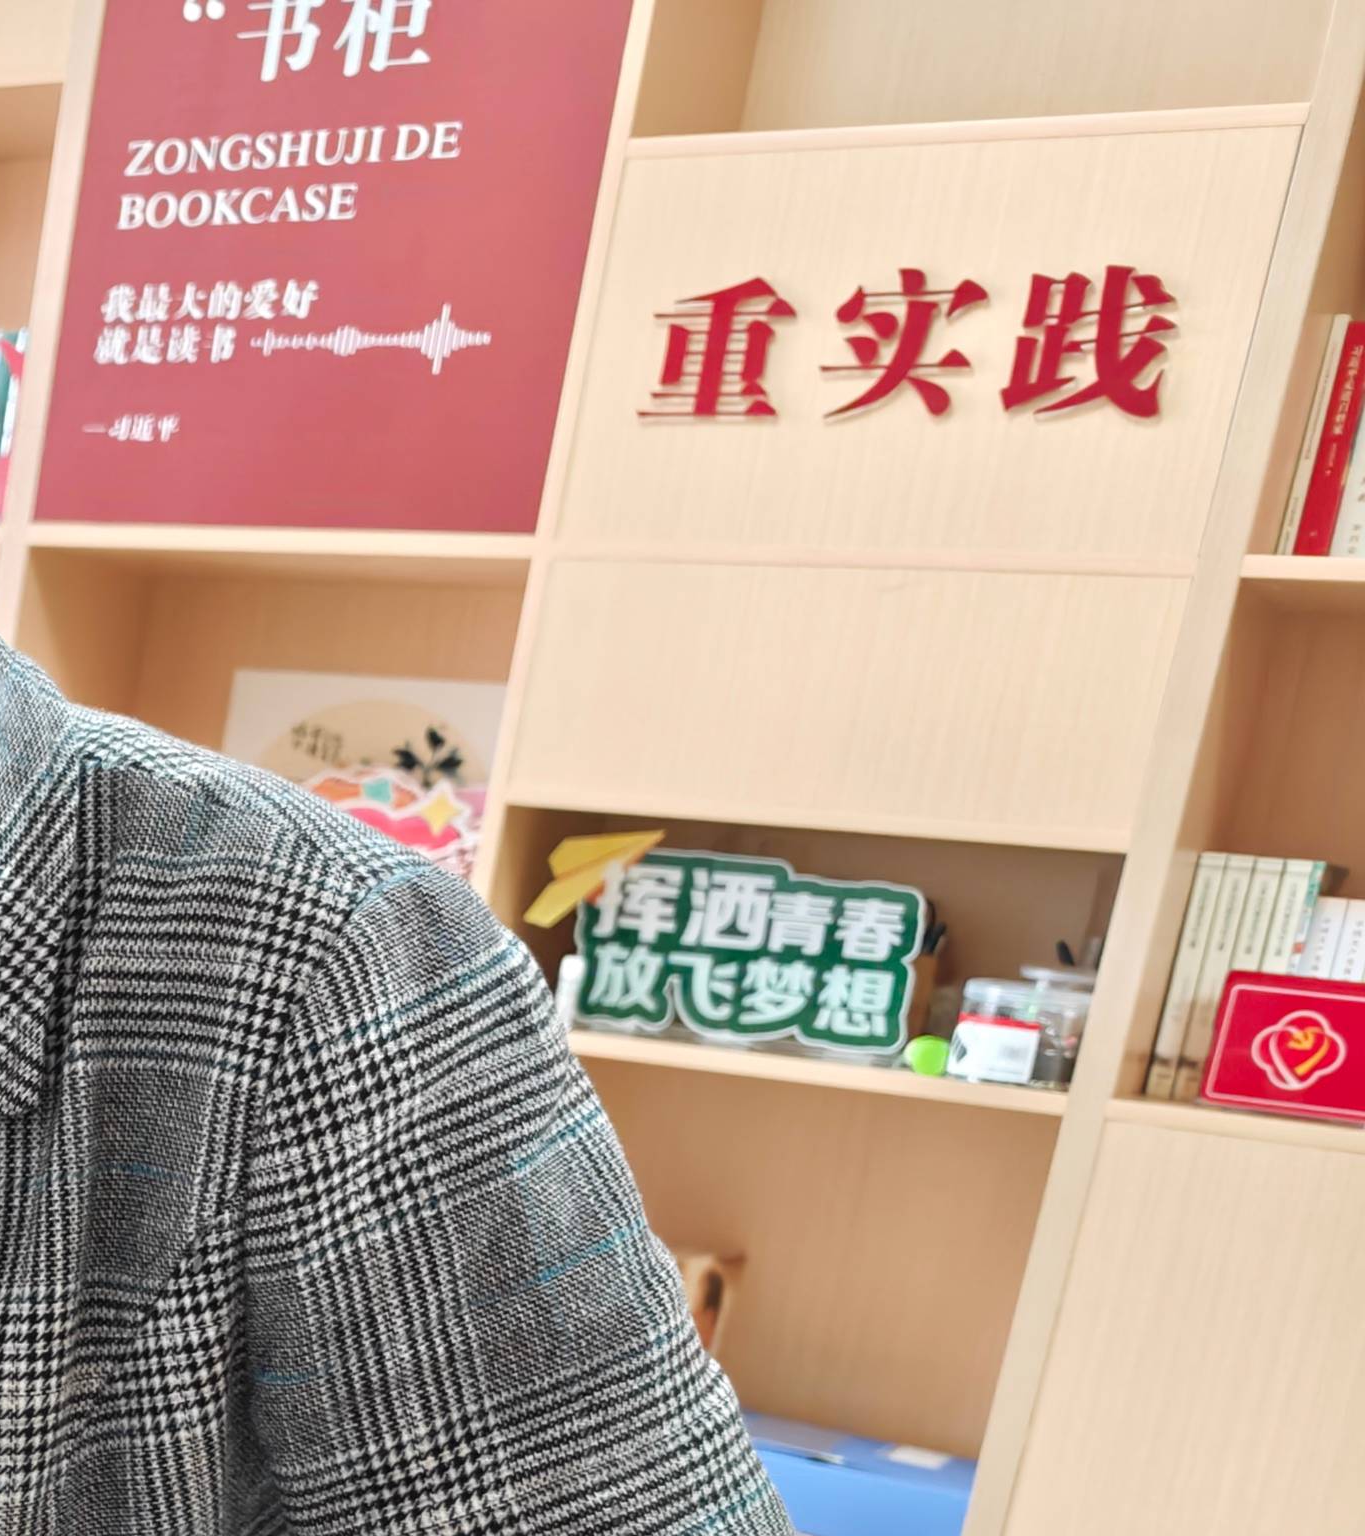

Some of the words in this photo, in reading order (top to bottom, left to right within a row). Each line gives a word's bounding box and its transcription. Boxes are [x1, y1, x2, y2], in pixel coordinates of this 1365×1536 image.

[124, 125, 387, 177] ZONGSHUJI
[391, 121, 463, 162] DE
[116, 182, 359, 231] BOOKCASE
[101, 278, 319, 324] 我最大的爱好
[93, 322, 237, 365] 就是读书
[636, 264, 1179, 424] 重实践
[592, 861, 906, 962] 挥洒青春
[587, 942, 895, 1037] 放飞梦想
